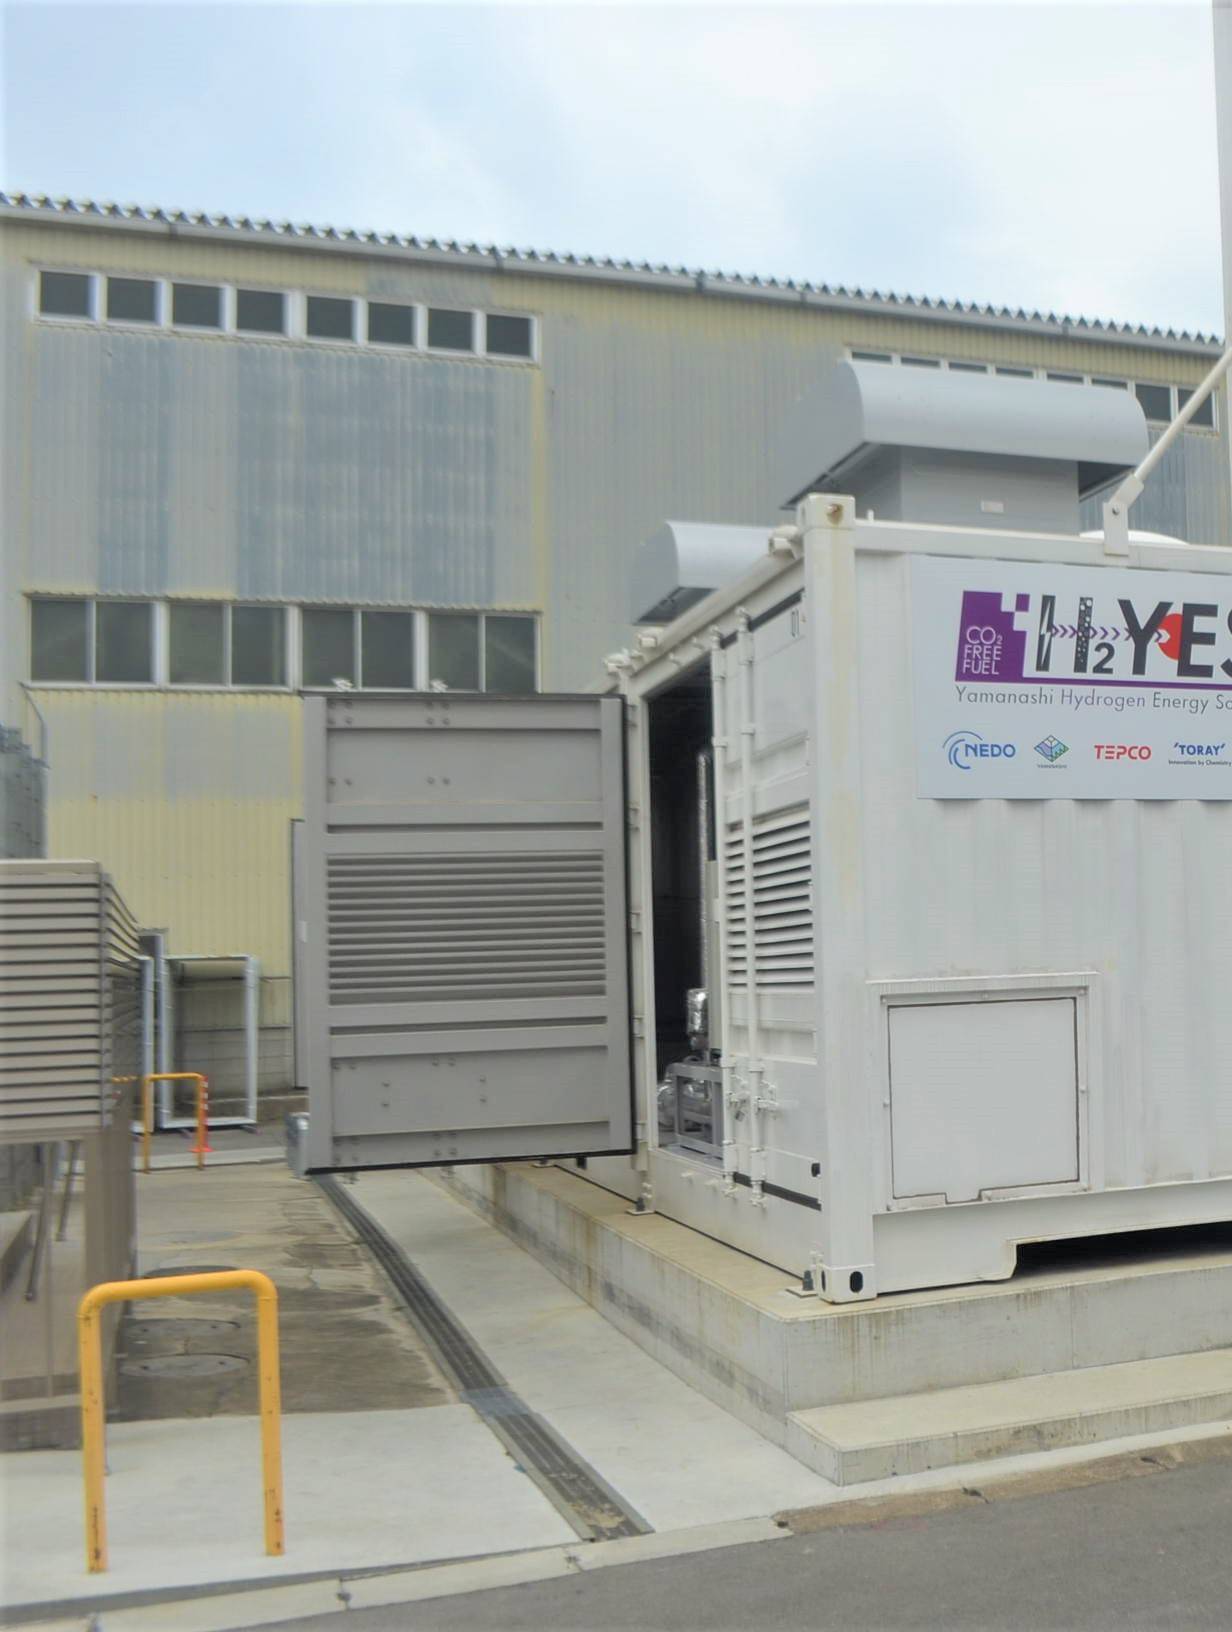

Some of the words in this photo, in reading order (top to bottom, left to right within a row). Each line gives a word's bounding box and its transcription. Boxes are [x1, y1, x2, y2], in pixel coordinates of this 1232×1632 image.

[964, 644, 1002, 660] FREE
[962, 659, 999, 675] FUEL
[955, 685, 1053, 704] Yamanashi
[1061, 688, 1145, 711] Hydrogen
[1152, 691, 1209, 714] Energy
[965, 743, 1016, 758] NEDO
[1094, 745, 1152, 760] TEPCO
[1206, 759, 1232, 768] Chemistry
